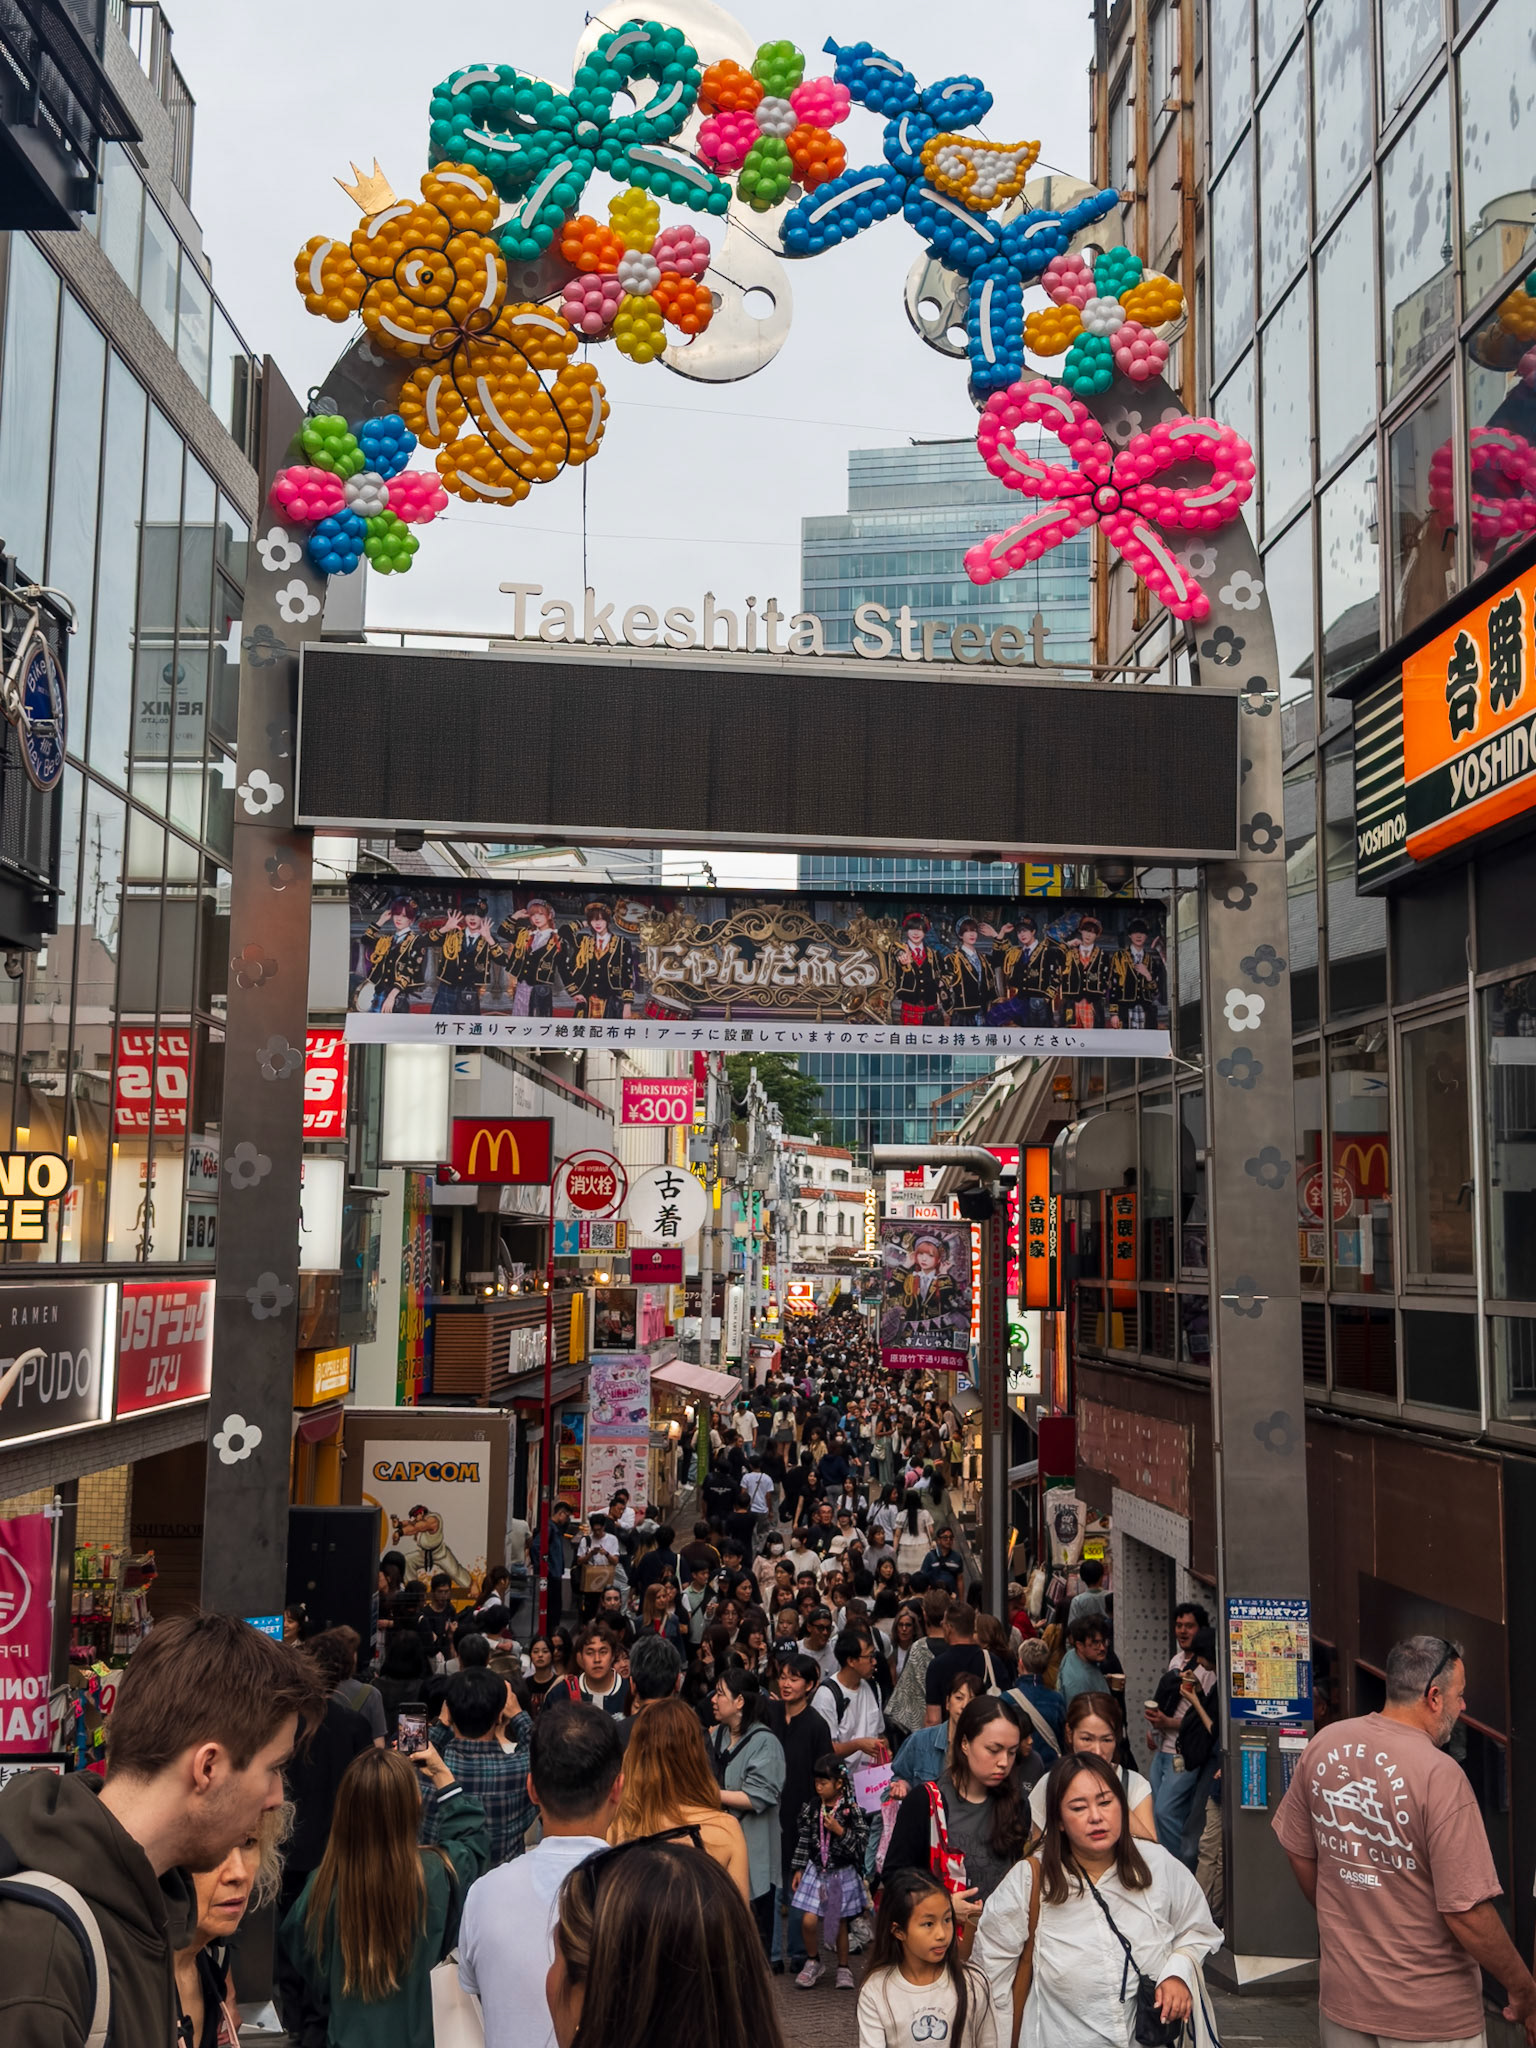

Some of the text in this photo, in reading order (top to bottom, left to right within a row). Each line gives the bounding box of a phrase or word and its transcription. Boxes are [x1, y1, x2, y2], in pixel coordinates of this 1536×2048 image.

[499, 582, 1054, 668] Takeshita Street
[630, 1083, 660, 1095] PARIS
[661, 1085, 688, 1096] KID'S
[628, 1098, 687, 1122] ¥300
[570, 1175, 614, 1196] 消火栓
[653, 1170, 685, 1237] 古着
[915, 1208, 938, 1217] NOA
[12, 1305, 59, 1326] RAMEN
[145, 1353, 182, 1397] クスリ
[373, 1460, 481, 1483] CAPCOM
[1311, 1743, 1367, 1797] MONTE
[1375, 1752, 1410, 1825] CARLO
[1315, 1828, 1417, 1870] YACHT CLUB
[1339, 1867, 1382, 1887] CASSIEL
